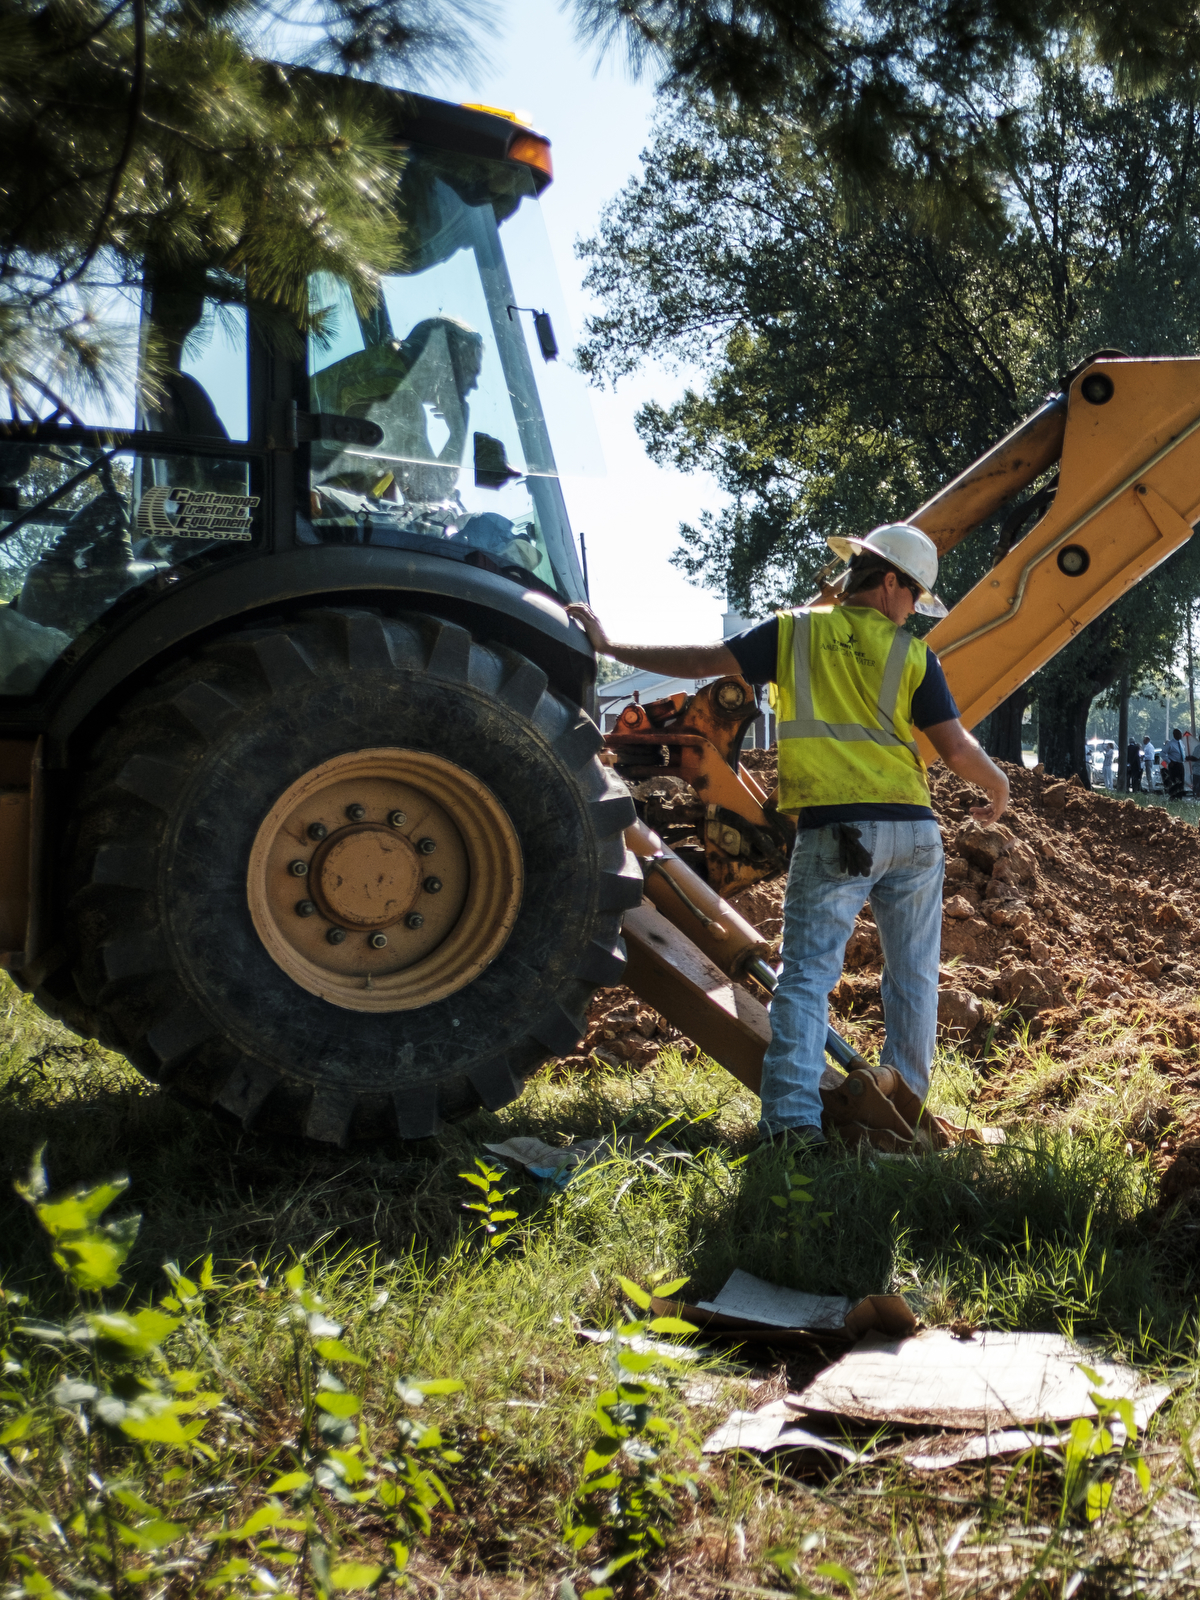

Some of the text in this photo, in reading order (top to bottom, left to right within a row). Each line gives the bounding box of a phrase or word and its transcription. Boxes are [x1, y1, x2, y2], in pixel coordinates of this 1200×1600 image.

[169, 488, 260, 508] Chattanooga
[176, 503, 246, 517] Tractor &
[176, 516, 253, 529] Equipment
